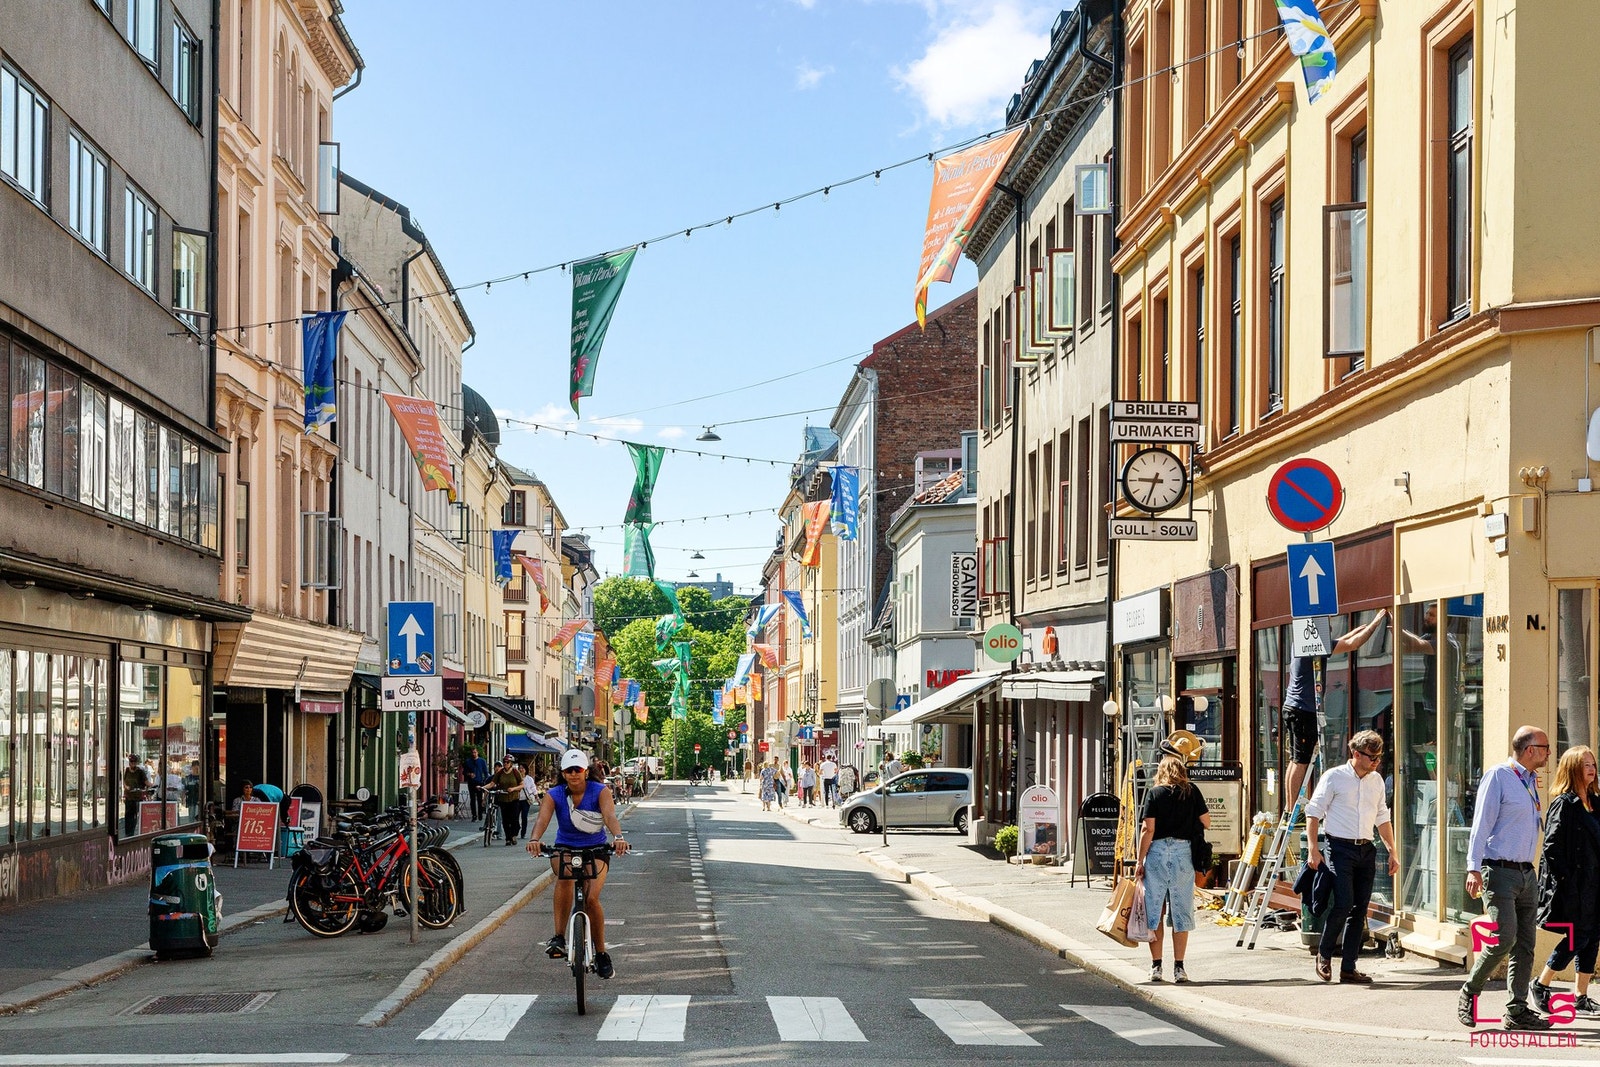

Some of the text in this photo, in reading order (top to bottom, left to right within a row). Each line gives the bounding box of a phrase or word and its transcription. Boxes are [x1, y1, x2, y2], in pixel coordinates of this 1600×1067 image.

[1125, 404, 1188, 416] BRILLER
[1117, 424, 1194, 437] URMAKER
[1114, 524, 1149, 535] GULL
[1160, 525, 1194, 536] SØLV
[951, 556, 960, 617] POSTMODERN
[960, 556, 976, 617] GANNI
[1526, 614, 1546, 630] N.
[989, 634, 1018, 649] olio
[1302, 643, 1323, 653] unntatt
[394, 698, 431, 708] unntatt
[1031, 794, 1048, 802] olio
